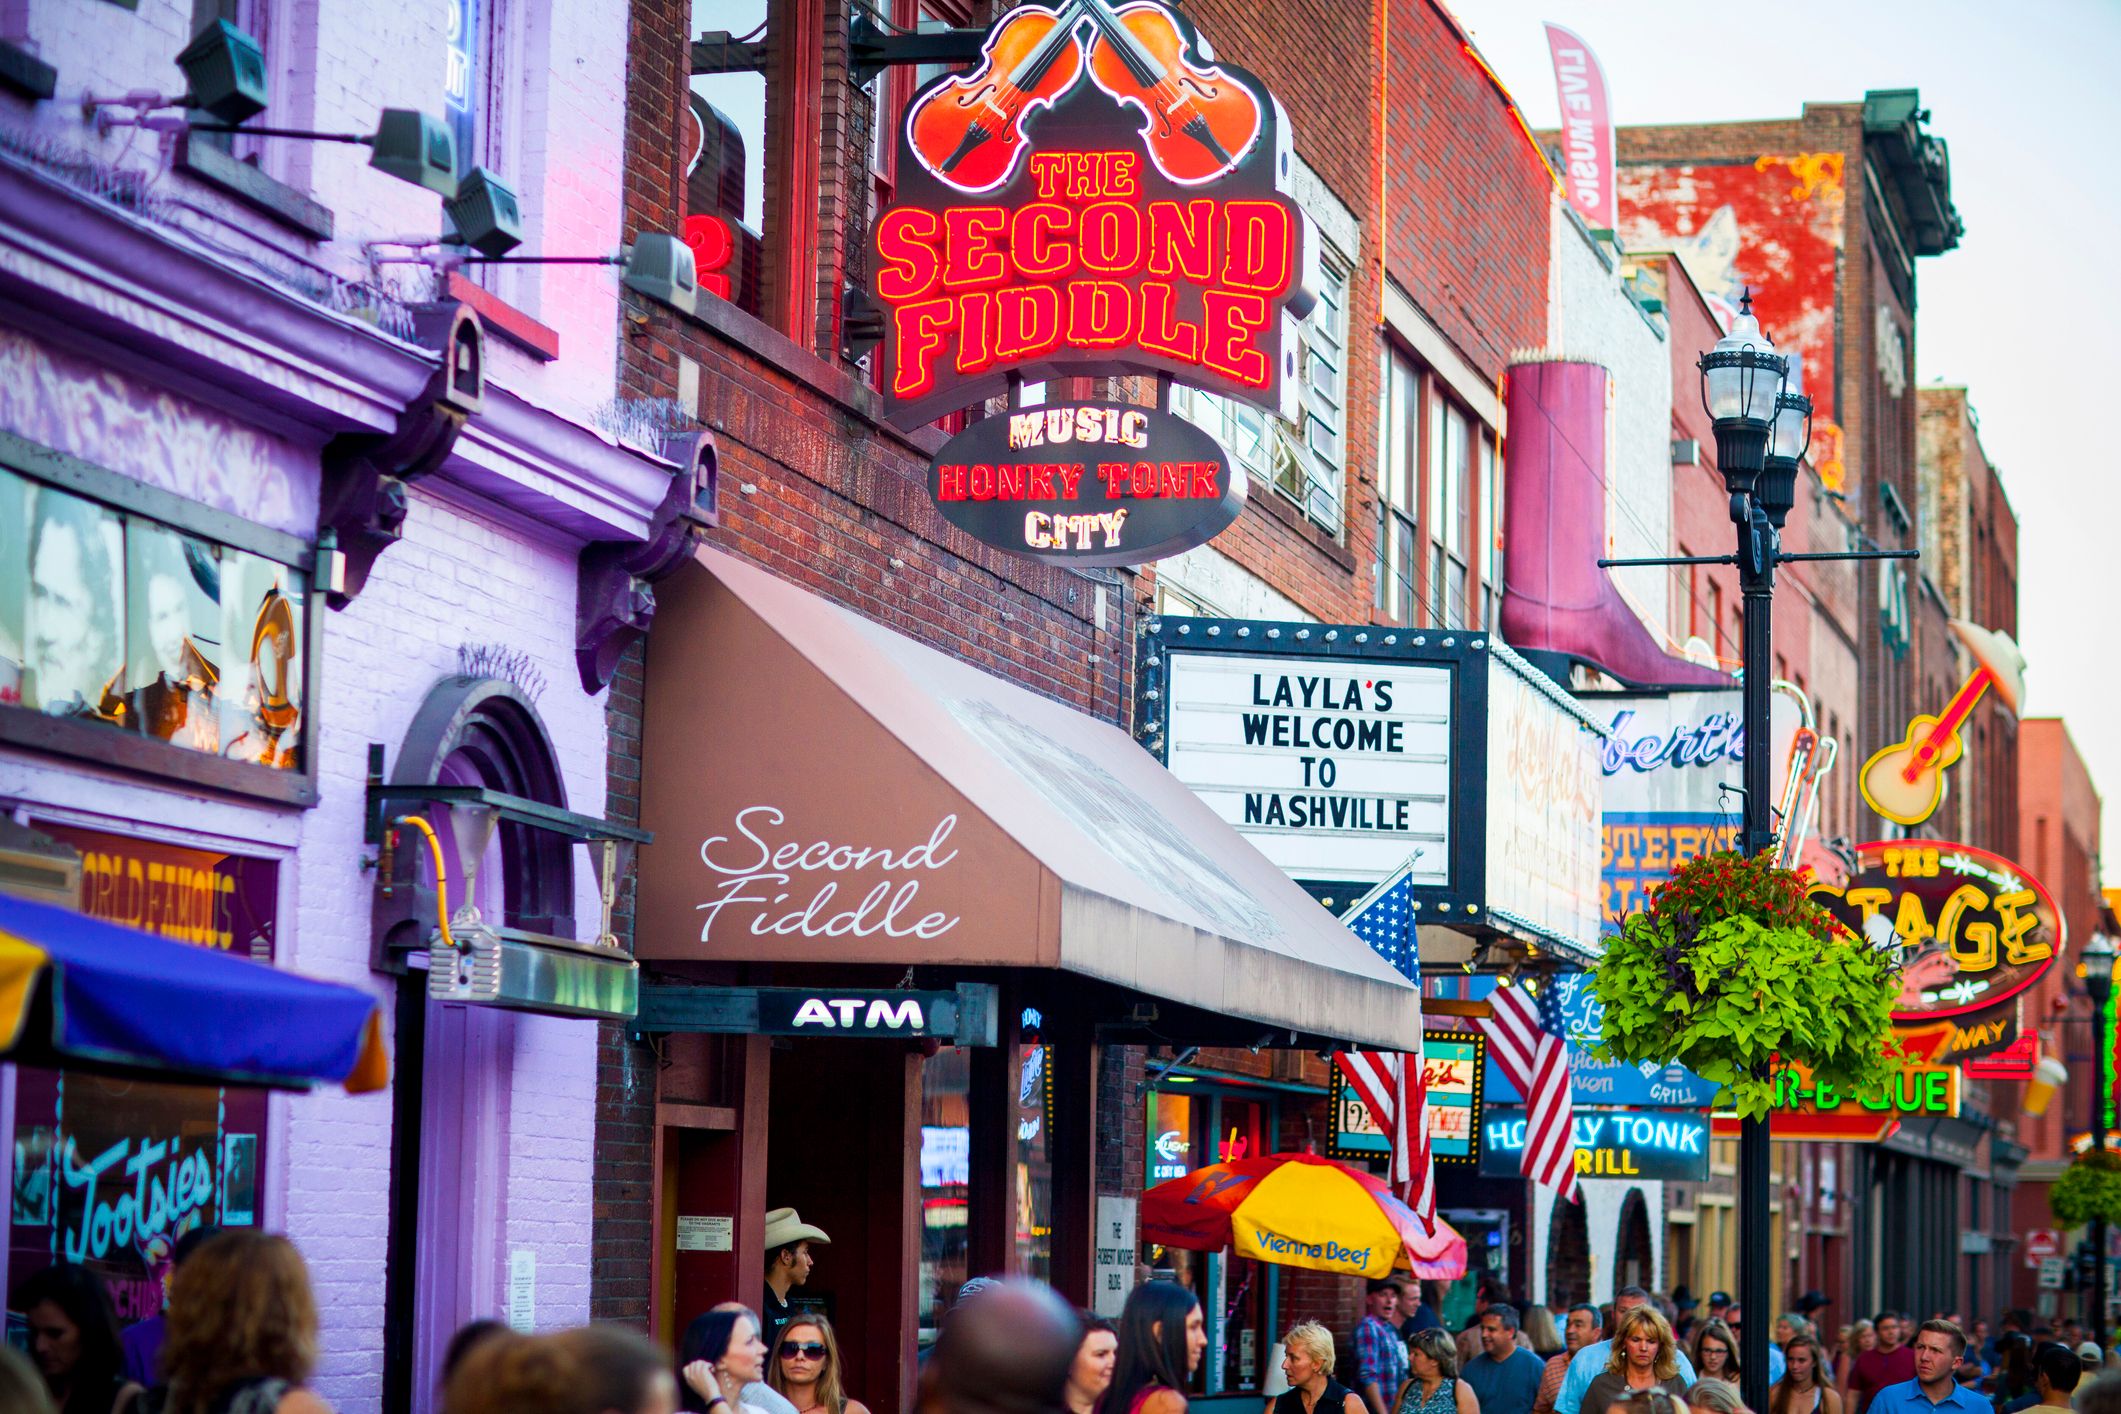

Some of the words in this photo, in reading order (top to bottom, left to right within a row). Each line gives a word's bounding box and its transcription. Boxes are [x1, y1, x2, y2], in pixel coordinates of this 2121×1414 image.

[1030, 151, 1139, 199] THE
[876, 198, 1293, 300] SECOND
[893, 279, 1270, 397] FIDDLE
[1009, 407, 1148, 449] MUSIC
[938, 463, 1085, 501] HONKY
[1097, 461, 1221, 499] TONK
[1024, 508, 1130, 550] CITY
[1252, 673, 1393, 712] LAYLA'S
[1242, 713, 1404, 753] WELCOME
[1300, 756, 1336, 788] TO
[1244, 793, 1409, 830] NASHVILLE
[700, 806, 959, 875] Second
[1883, 848, 1940, 878] THE
[79, 850, 144, 929] ORLD
[145, 861, 236, 951] FAMOUS
[696, 873, 960, 942] Fiddle
[792, 999, 924, 1029] ATM
[1650, 1083, 1697, 1104] GRILL
[1610, 1116, 1704, 1154] TONK
[1574, 1148, 1640, 1175] RILL
[63, 1135, 213, 1265] Tootsies
[1255, 1231, 1323, 1259] Vienna
[1326, 1240, 1371, 1271] Beef
